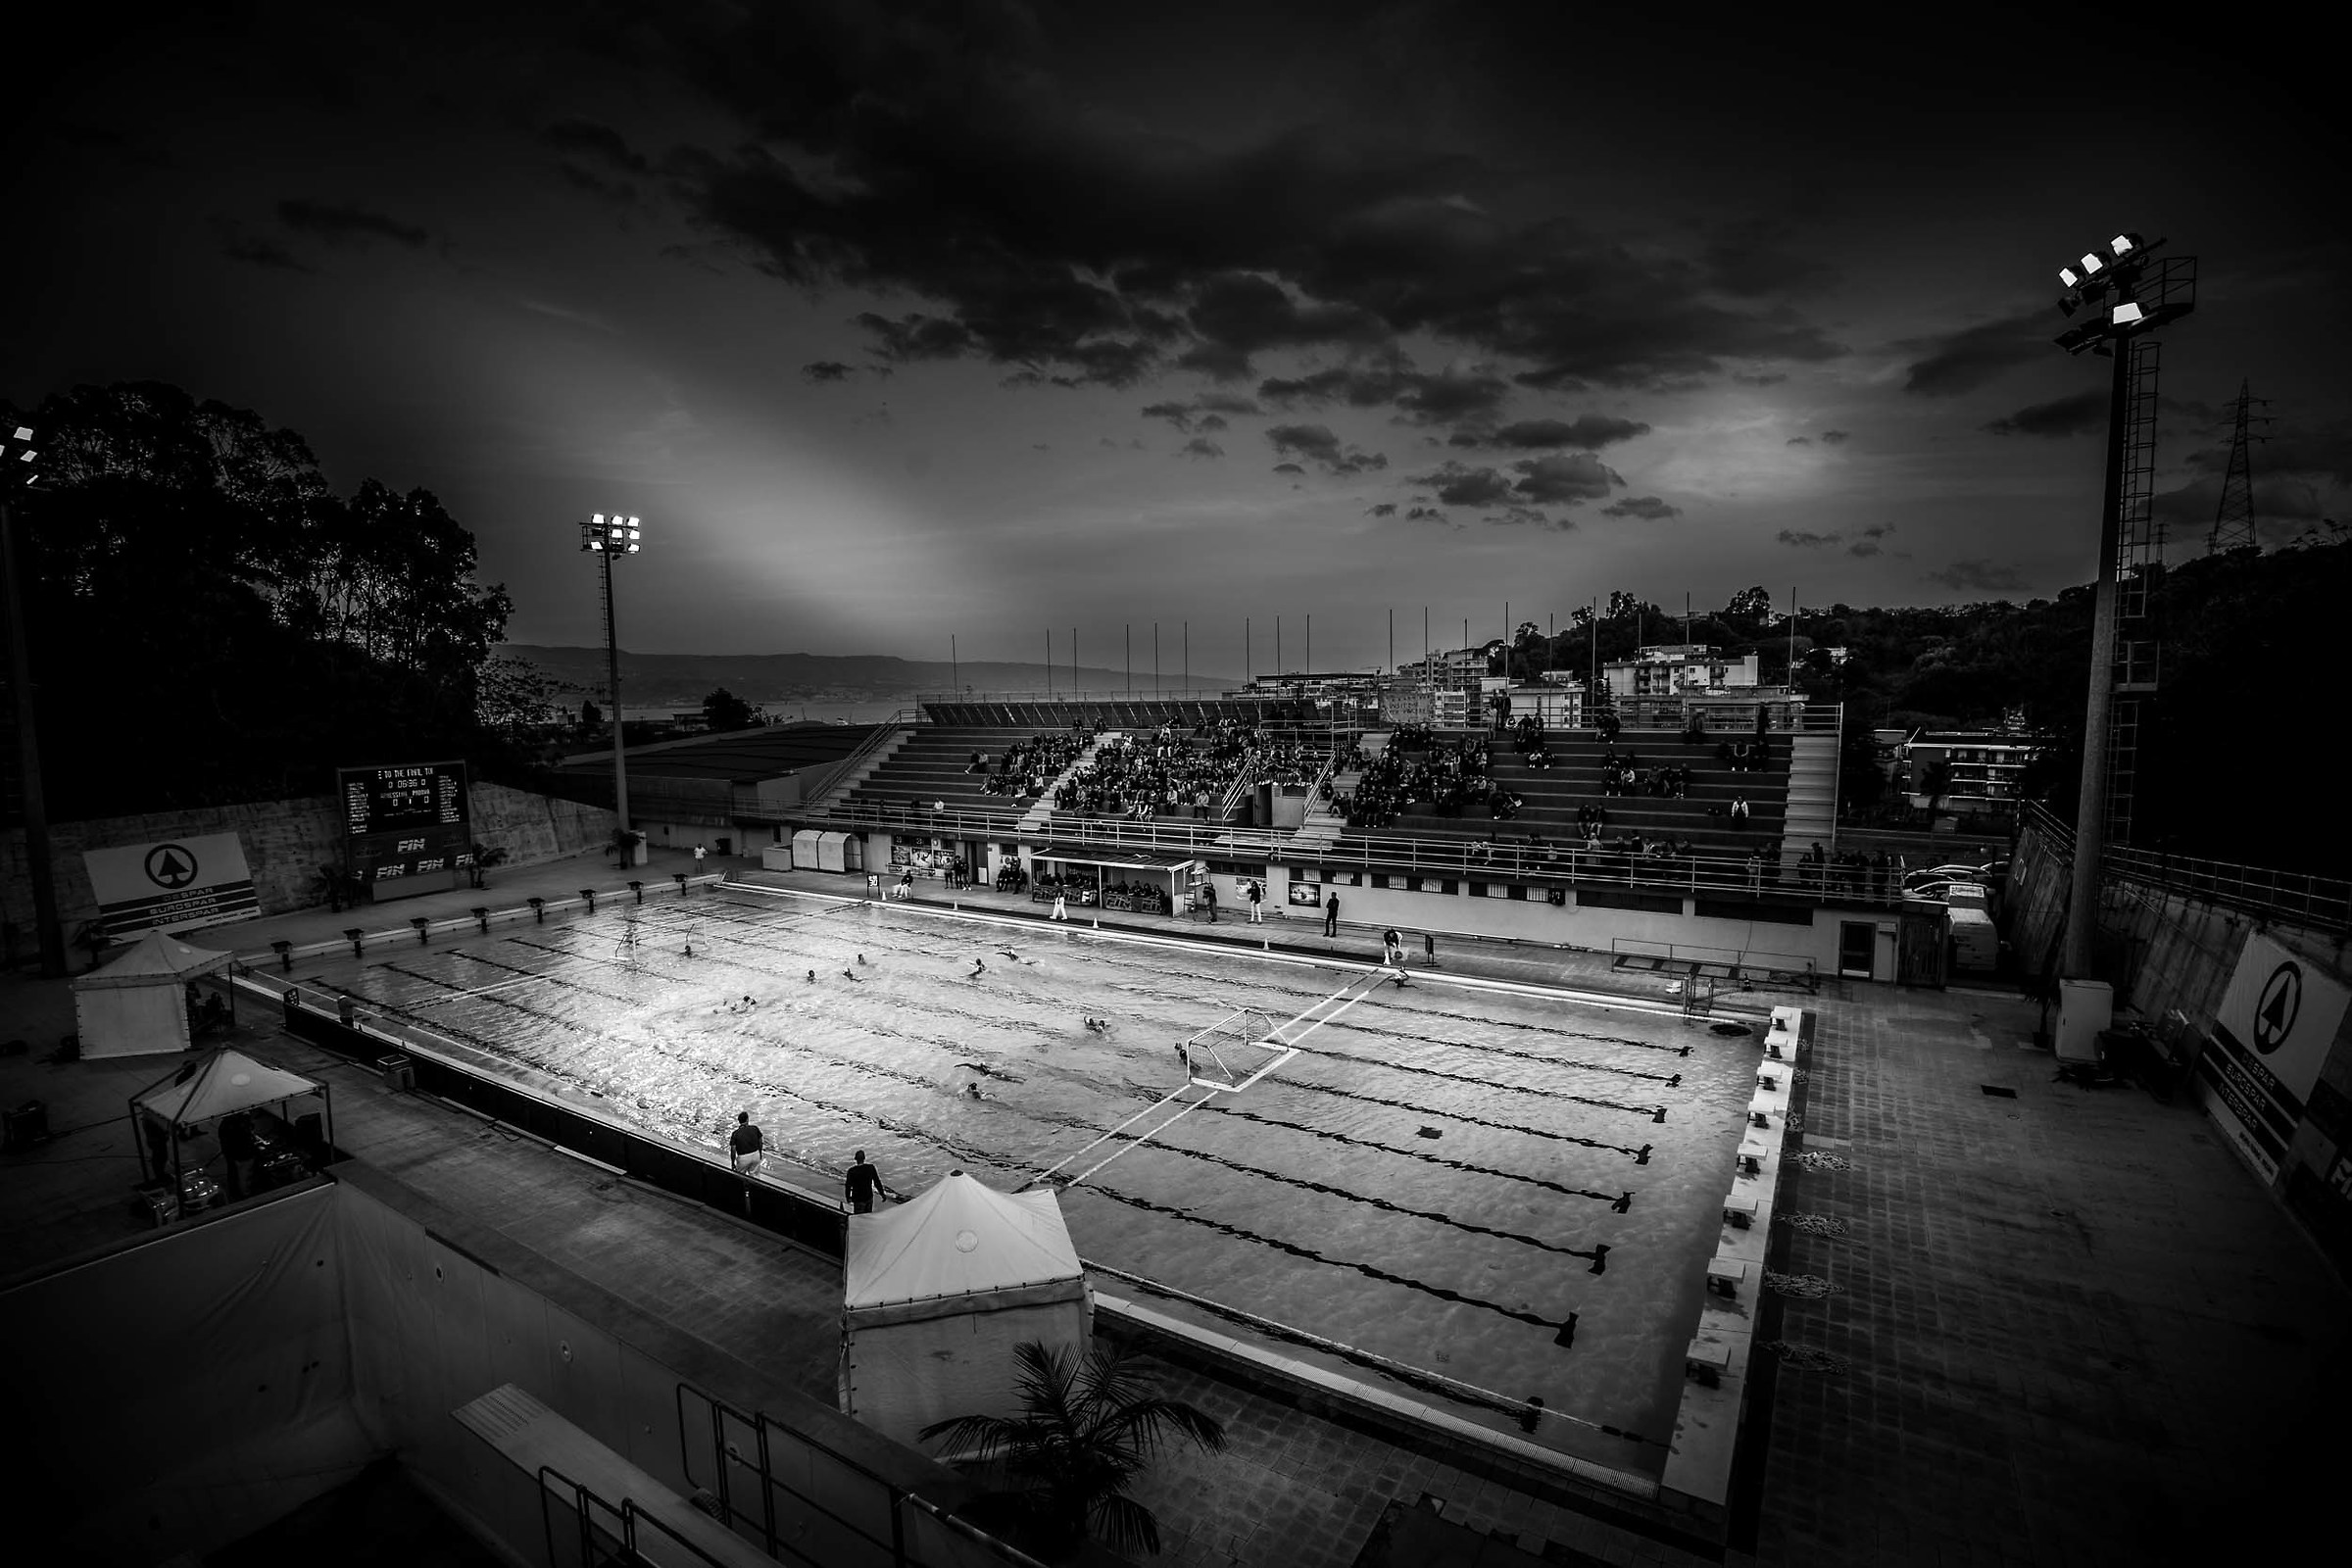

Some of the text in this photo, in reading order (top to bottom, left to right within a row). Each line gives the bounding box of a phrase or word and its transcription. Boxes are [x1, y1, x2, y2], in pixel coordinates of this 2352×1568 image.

[397, 838, 425, 854] FIN
[375, 863, 405, 880] FIN
[416, 858, 445, 873] FIN
[162, 887, 214, 903] DESPAR
[149, 897, 217, 915] EUROSPAR
[151, 907, 219, 926] INTERSPAR
[2241, 1051, 2277, 1091] DESPAR
[2225, 1062, 2267, 1111] EUROSPAR
